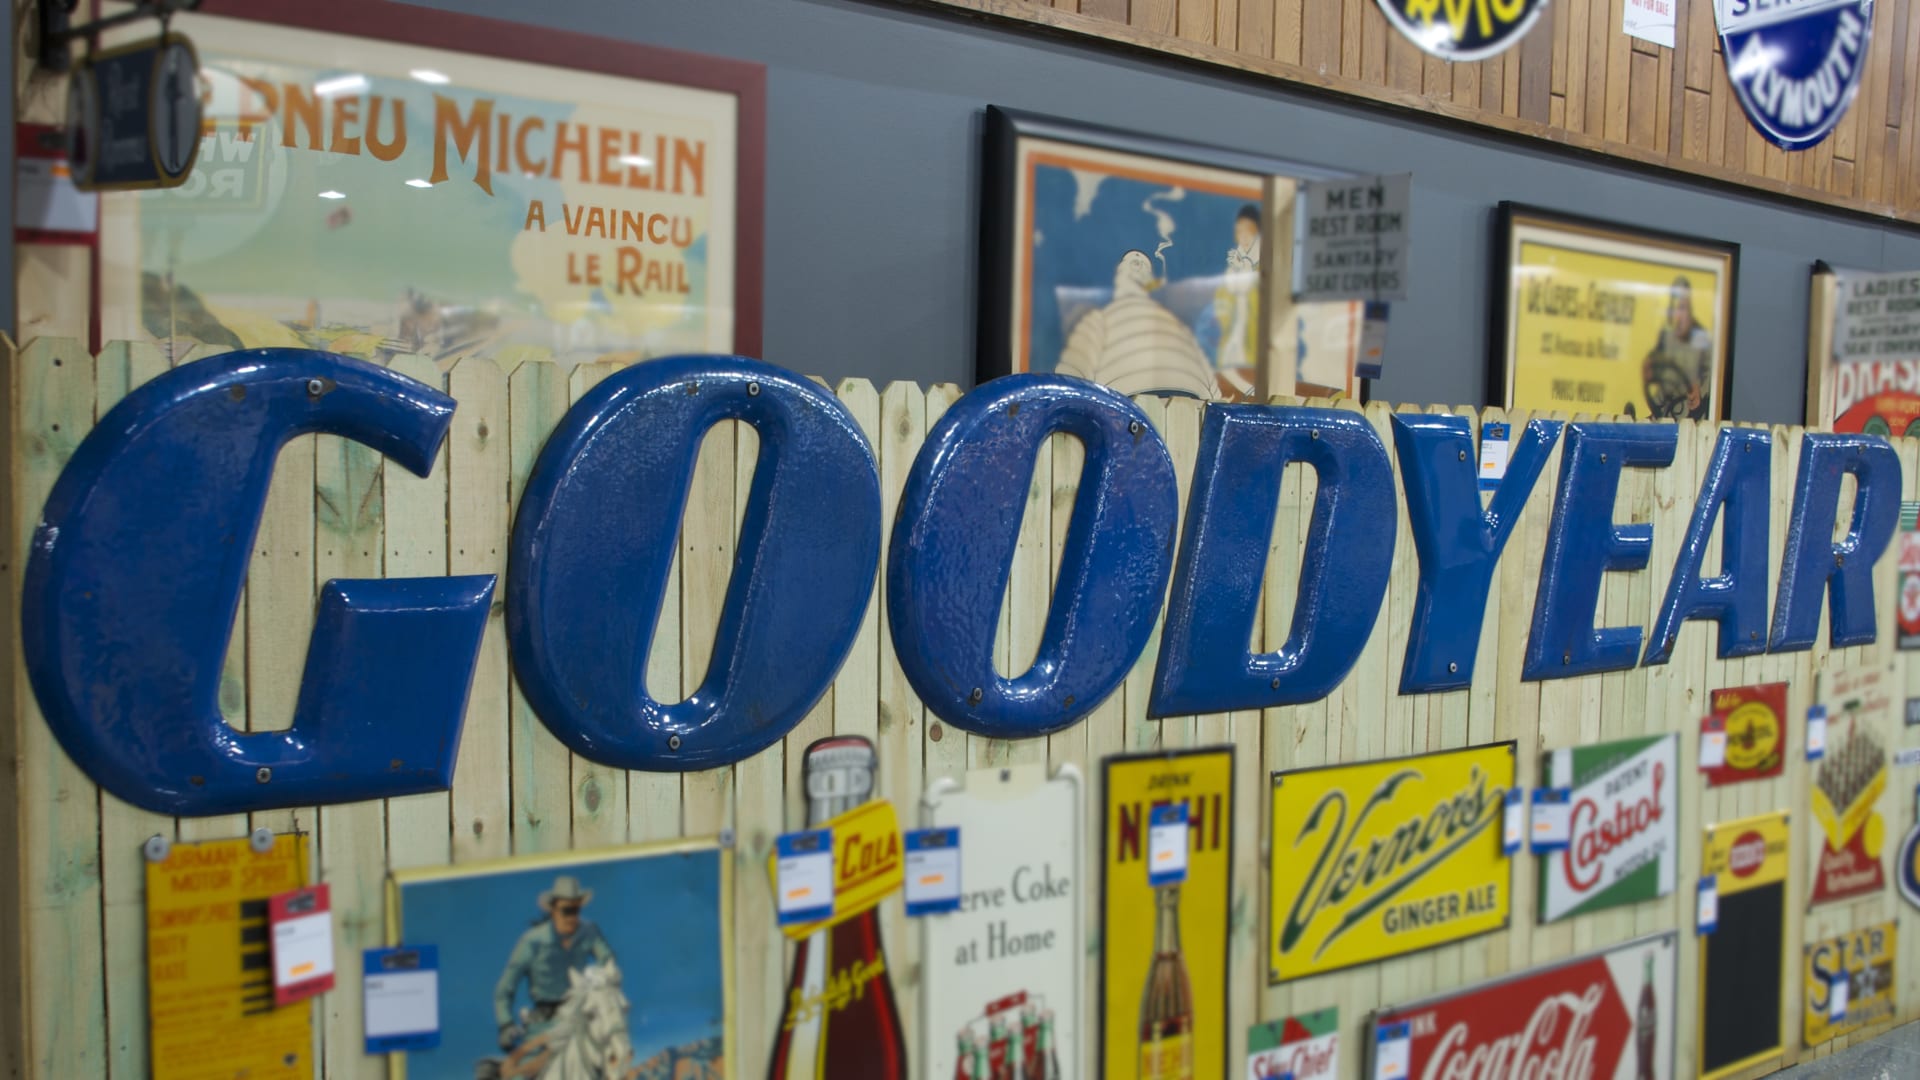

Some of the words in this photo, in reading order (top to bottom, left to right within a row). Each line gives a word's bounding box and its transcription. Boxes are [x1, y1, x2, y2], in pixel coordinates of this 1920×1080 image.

[1729, 9, 1862, 128] PLYMOUTH
[232, 75, 408, 162] PNEU
[429, 91, 706, 198] MICHELIN
[524, 199, 546, 232] A
[561, 203, 694, 249] VAINCU
[1309, 214, 1348, 237] REST
[1354, 211, 1402, 235] ROOM
[1325, 186, 1384, 212] MEN
[567, 252, 603, 286] LE
[616, 245, 691, 297] RAIL
[1313, 248, 1398, 269] SANITARY
[1854, 277, 1920, 298] LADIES
[22, 346, 1903, 817] GOODYEAR
[1605, 759, 1648, 797] PATENT
[1117, 793, 1223, 864] NHI
[1562, 760, 1665, 893] Castrol
[841, 832, 898, 880] COLA
[959, 885, 1006, 912] erve
[1012, 863, 1071, 904] Coke
[1382, 893, 1461, 935] GINGER
[1464, 883, 1497, 916] ALE
[954, 938, 978, 965] at
[986, 919, 1056, 960] Home
[1811, 929, 1886, 1013] STAR
